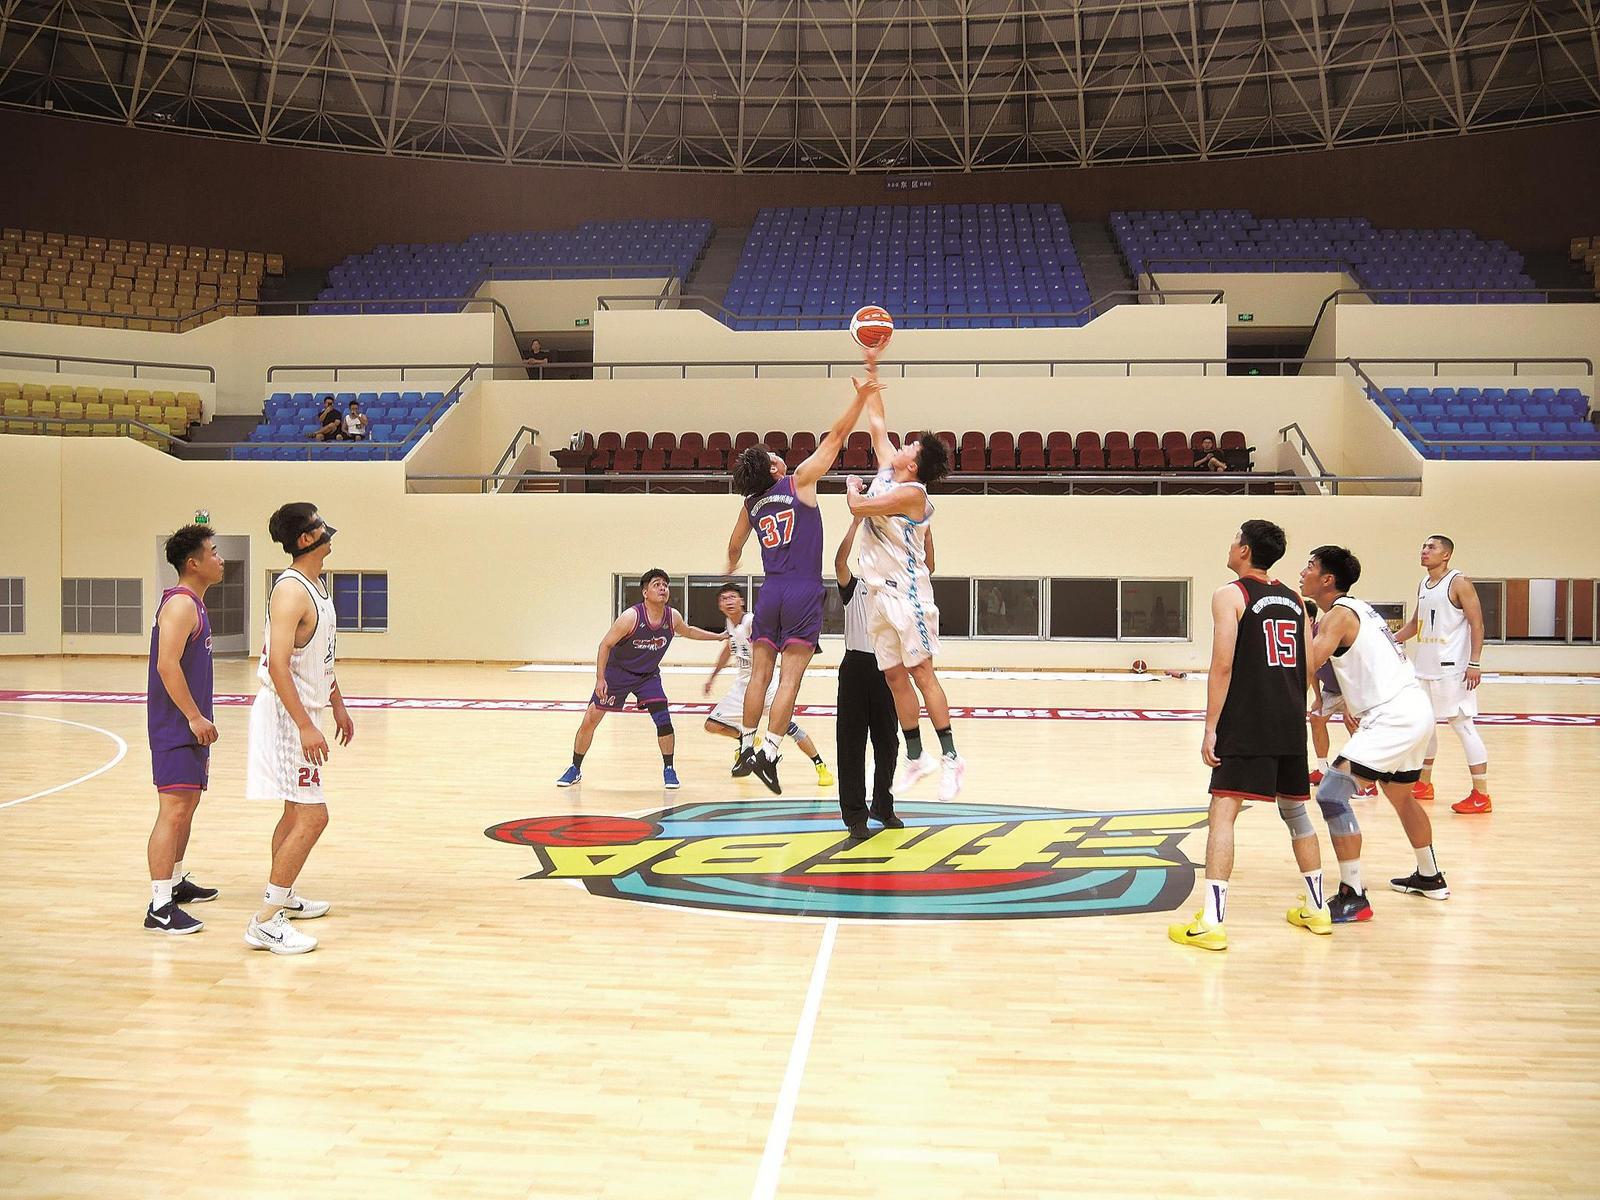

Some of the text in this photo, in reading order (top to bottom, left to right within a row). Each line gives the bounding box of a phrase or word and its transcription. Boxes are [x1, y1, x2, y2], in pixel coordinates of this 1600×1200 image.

[759, 508, 795, 549] 37
[1263, 618, 1297, 668] 15
[298, 767, 320, 787] 24
